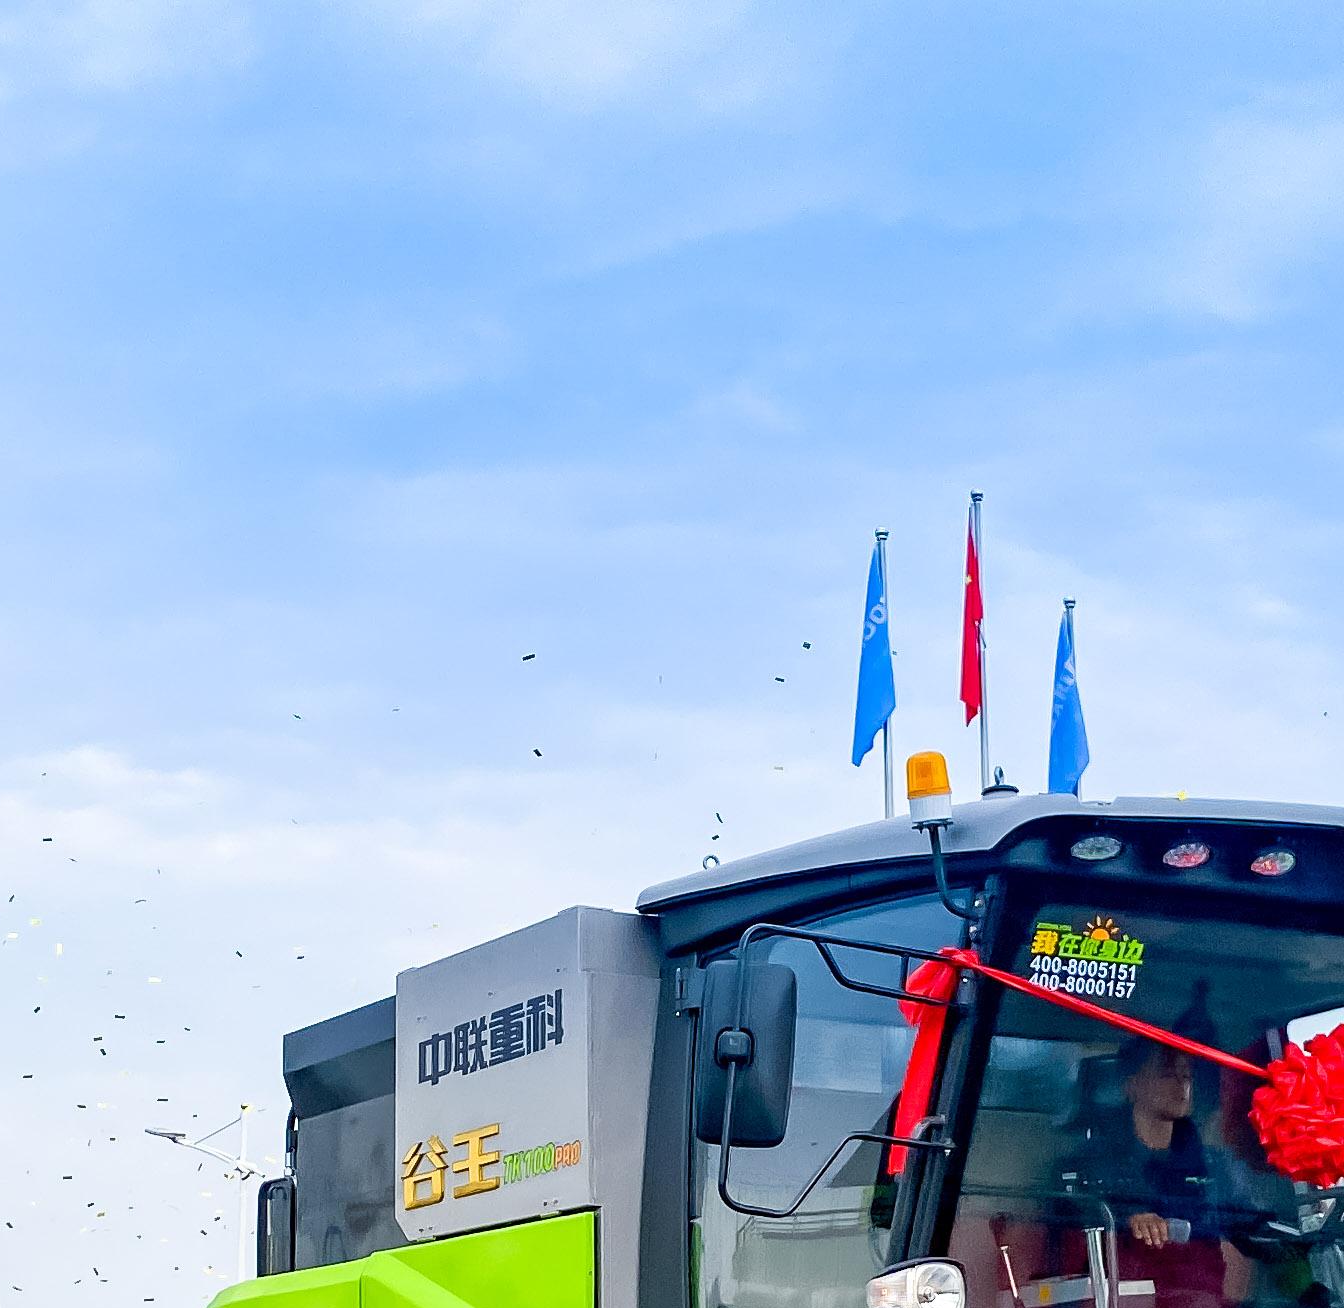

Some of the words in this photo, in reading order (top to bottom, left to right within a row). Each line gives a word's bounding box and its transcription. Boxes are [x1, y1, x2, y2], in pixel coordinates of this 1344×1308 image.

[1028, 973, 1136, 999] 400-8000157
[1029, 955, 1136, 980] 400-8005151
[418, 989, 564, 1085] 中联重科
[401, 1123, 501, 1211] 谷王
